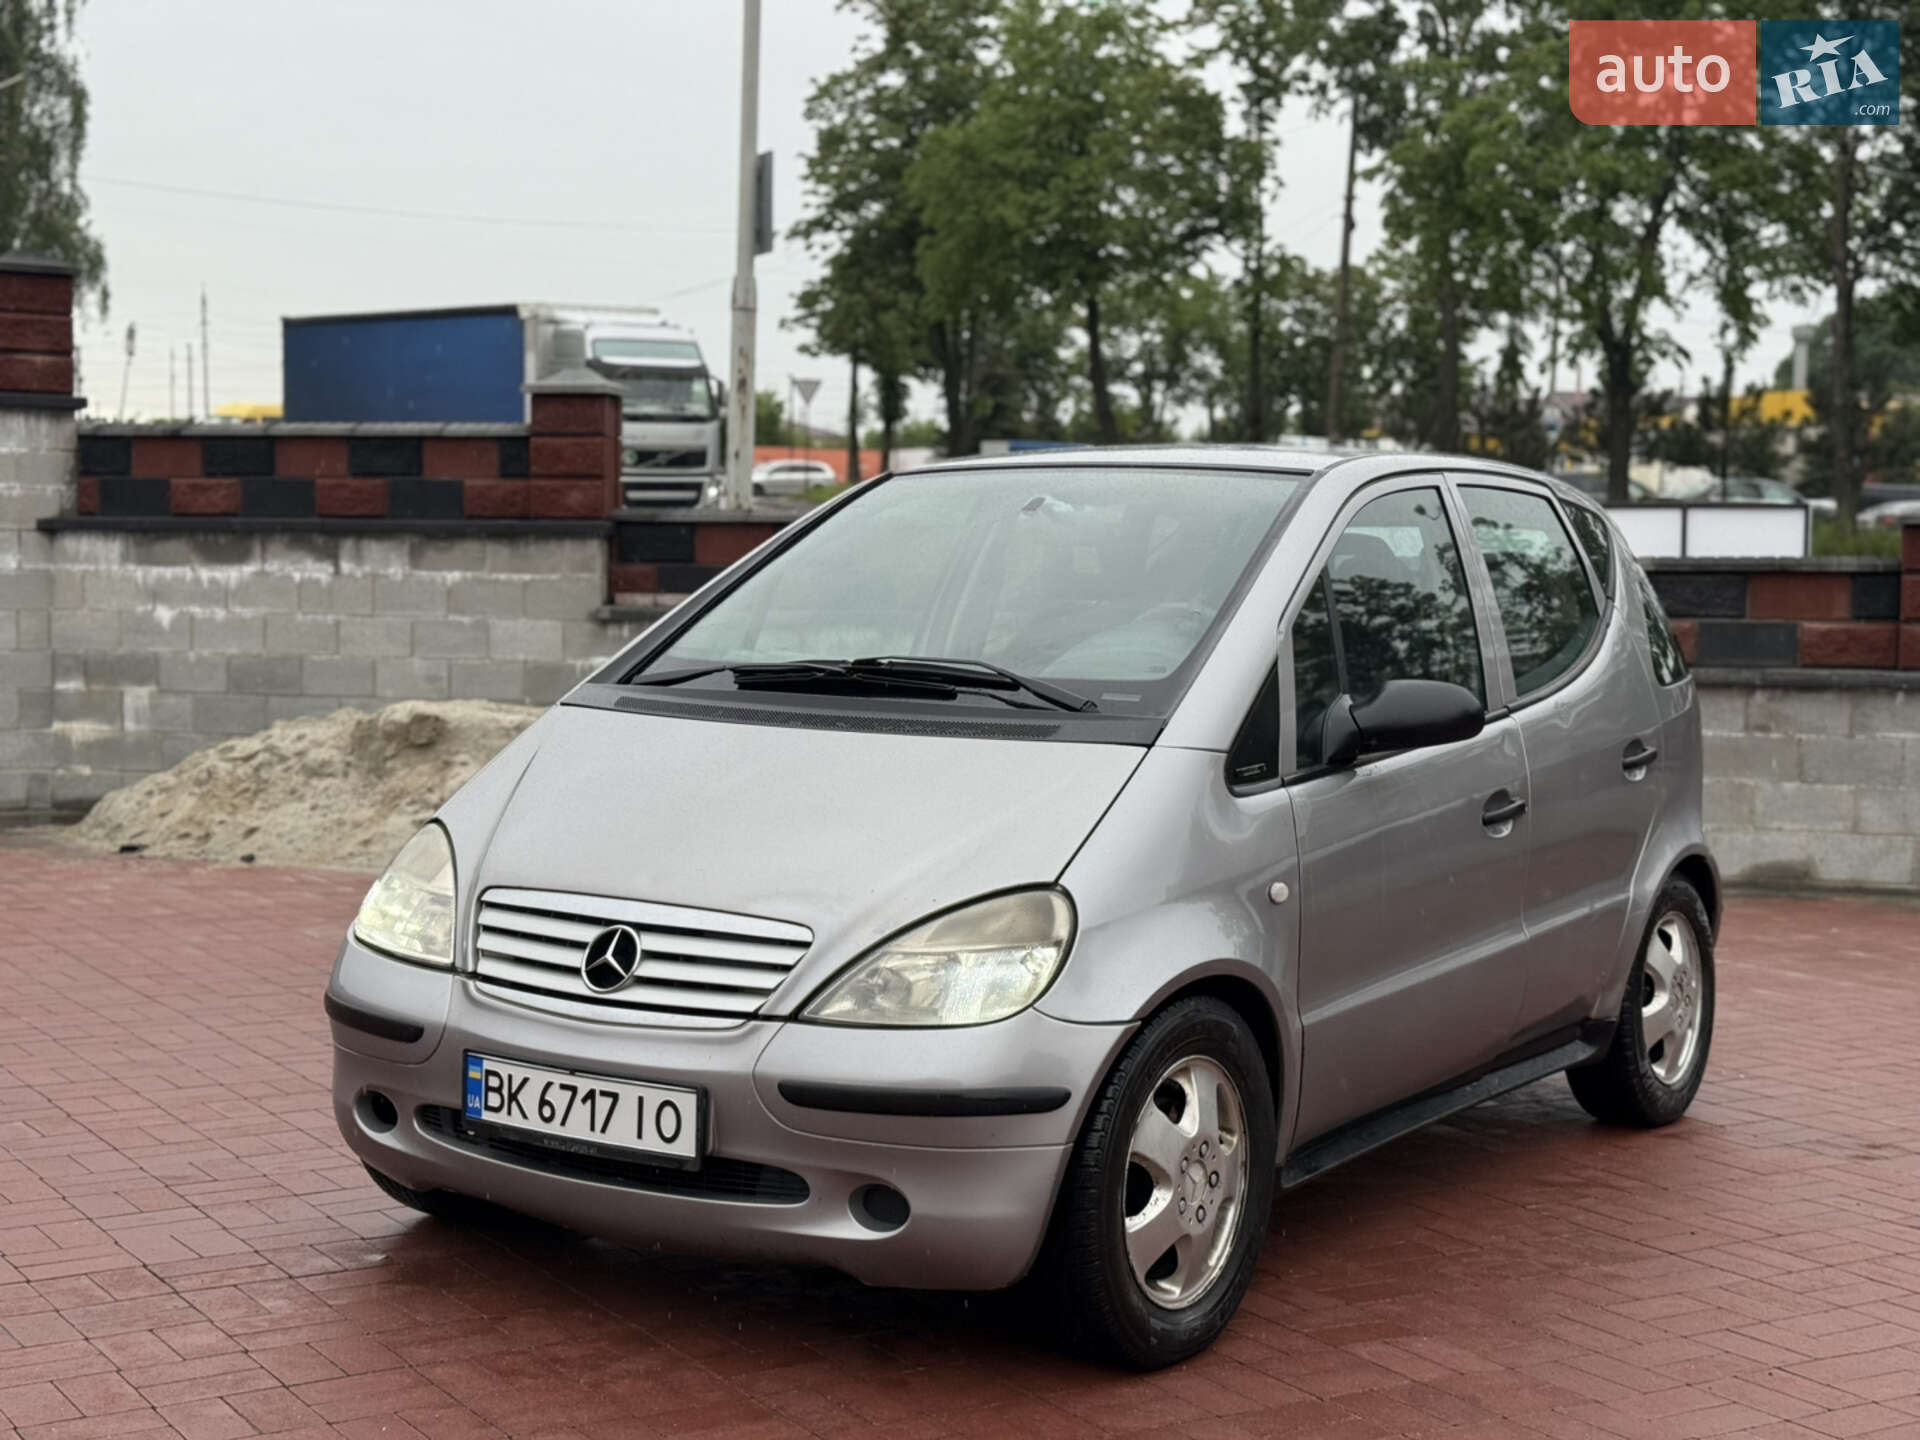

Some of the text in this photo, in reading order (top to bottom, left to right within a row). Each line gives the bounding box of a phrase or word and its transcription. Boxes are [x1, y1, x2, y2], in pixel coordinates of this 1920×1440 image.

[467, 1093, 481, 1110] UA
[484, 1069, 682, 1144] BK 6717 IO
